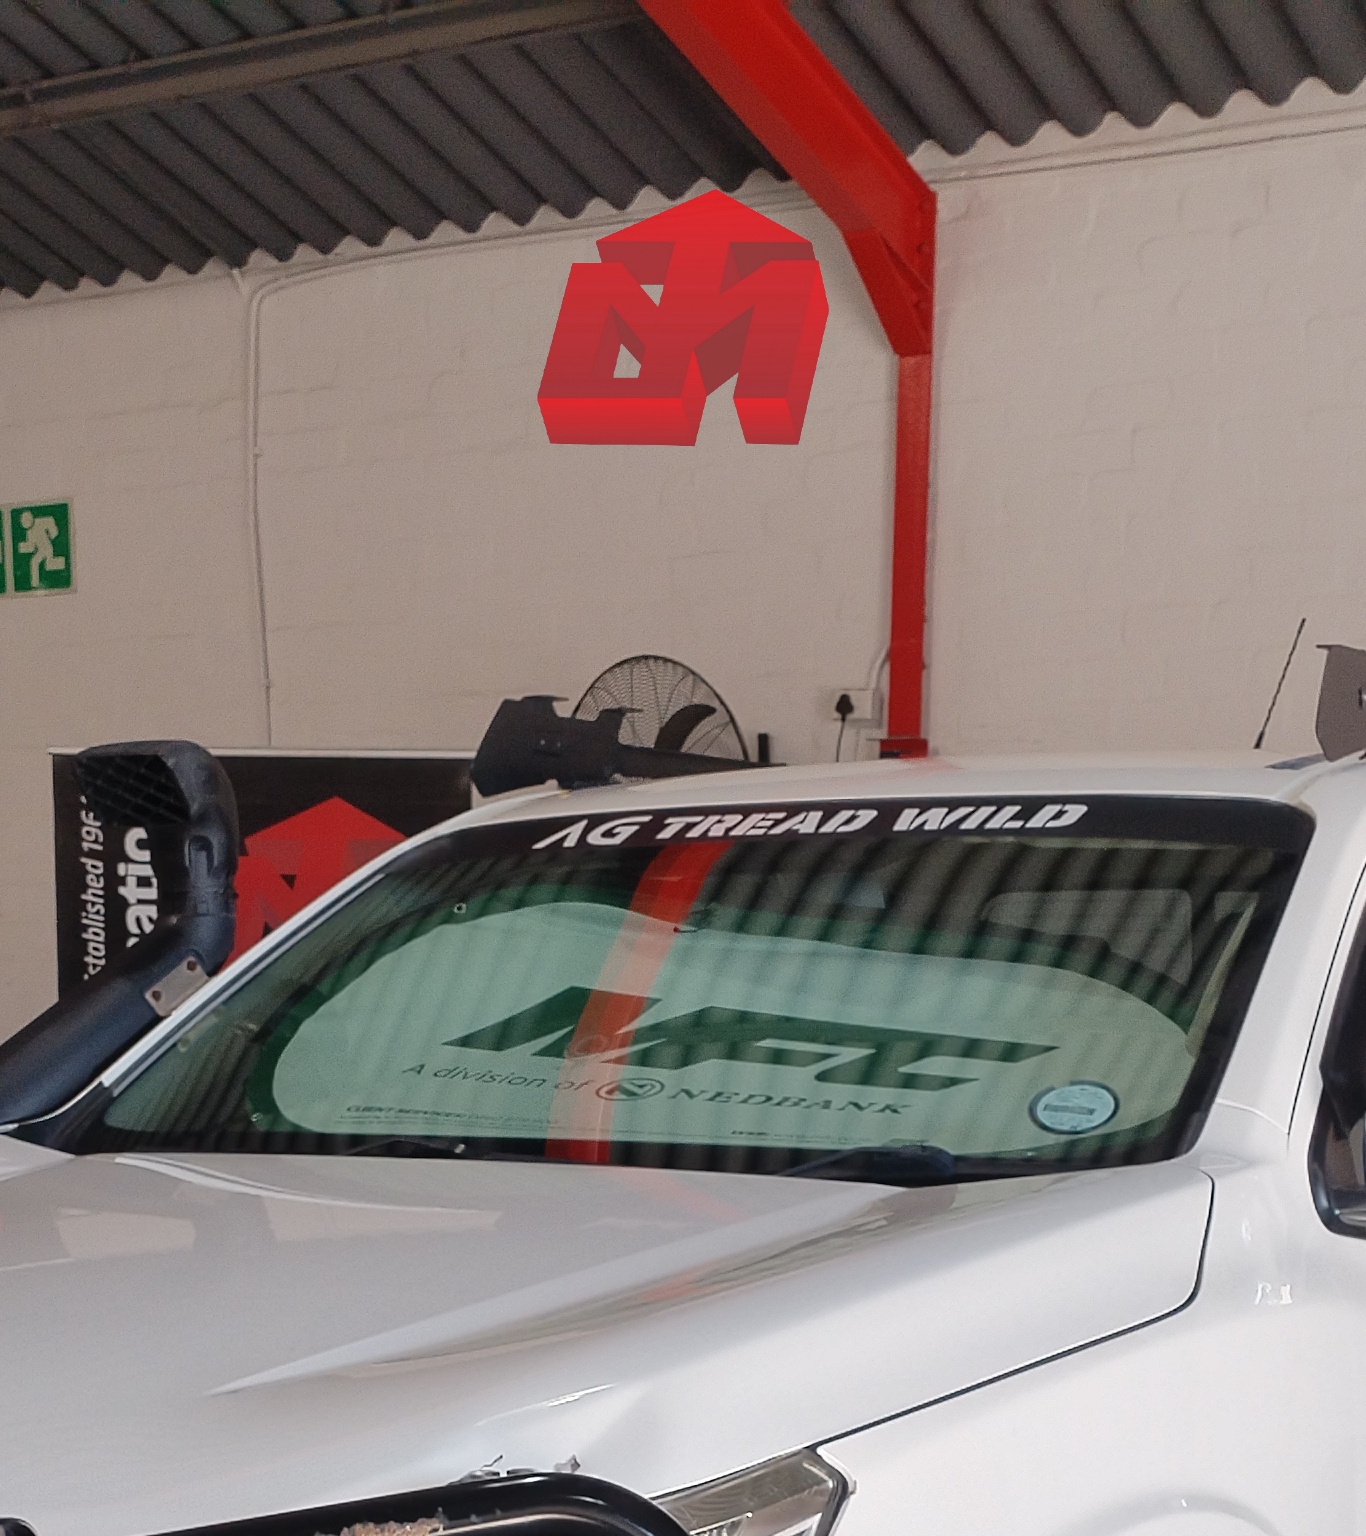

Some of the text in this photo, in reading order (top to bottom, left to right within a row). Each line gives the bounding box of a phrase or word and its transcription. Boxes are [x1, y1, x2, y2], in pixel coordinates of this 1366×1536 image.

[655, 808, 879, 841] TREAD
[891, 802, 1089, 832] WILD
[433, 1066, 545, 1090] division
[554, 1078, 589, 1093] of
[668, 1085, 912, 1116] NEDBANK
